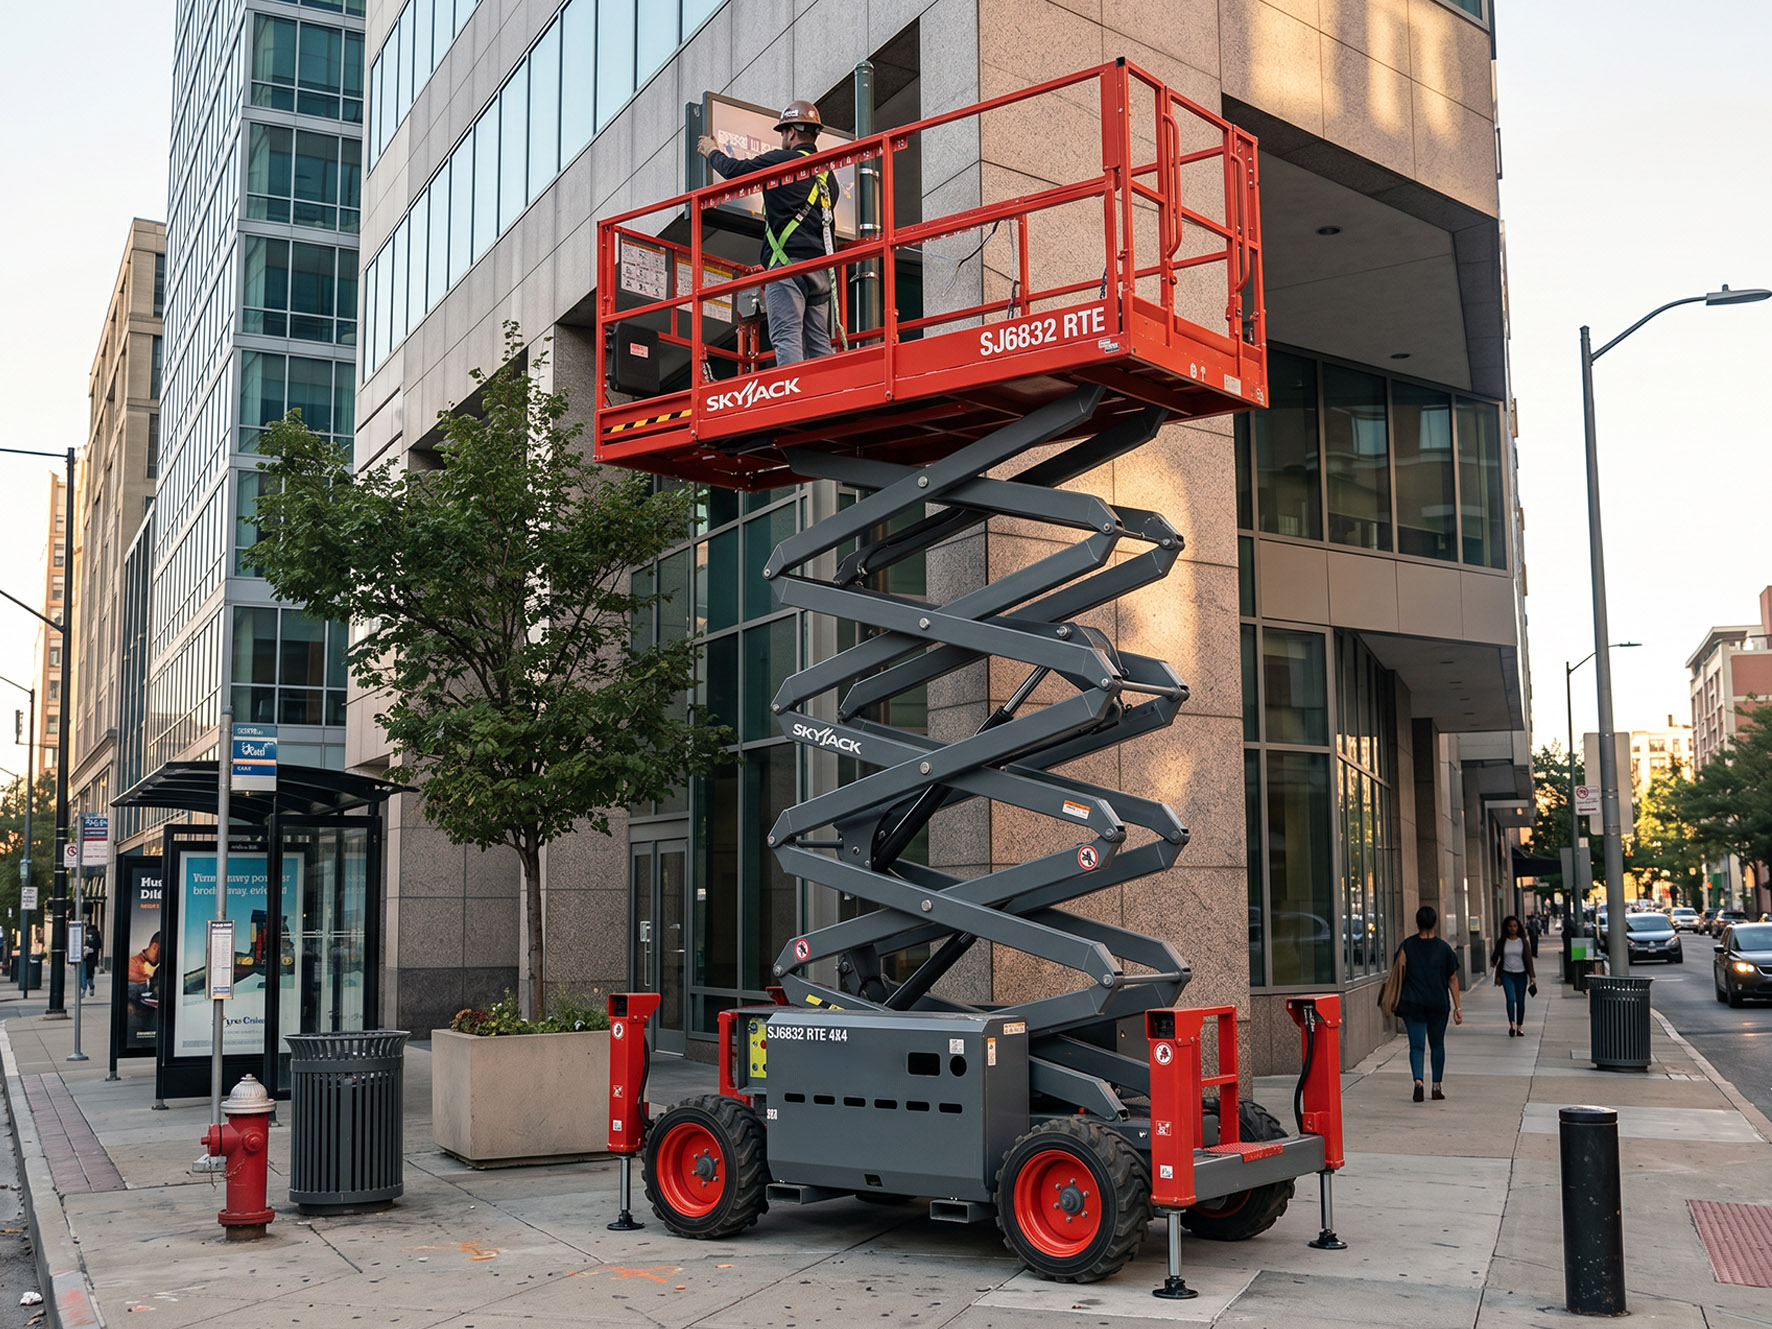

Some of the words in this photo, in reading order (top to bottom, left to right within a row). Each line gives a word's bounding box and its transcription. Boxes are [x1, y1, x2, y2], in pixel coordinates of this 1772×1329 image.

[980, 318, 1057, 356] SJ6832
[1063, 306, 1106, 339] RTE
[706, 377, 802, 412] SKYJACK
[792, 723, 863, 755] SKYJACK
[767, 1026, 804, 1040] SJ6832
[806, 1028, 826, 1041] RTE
